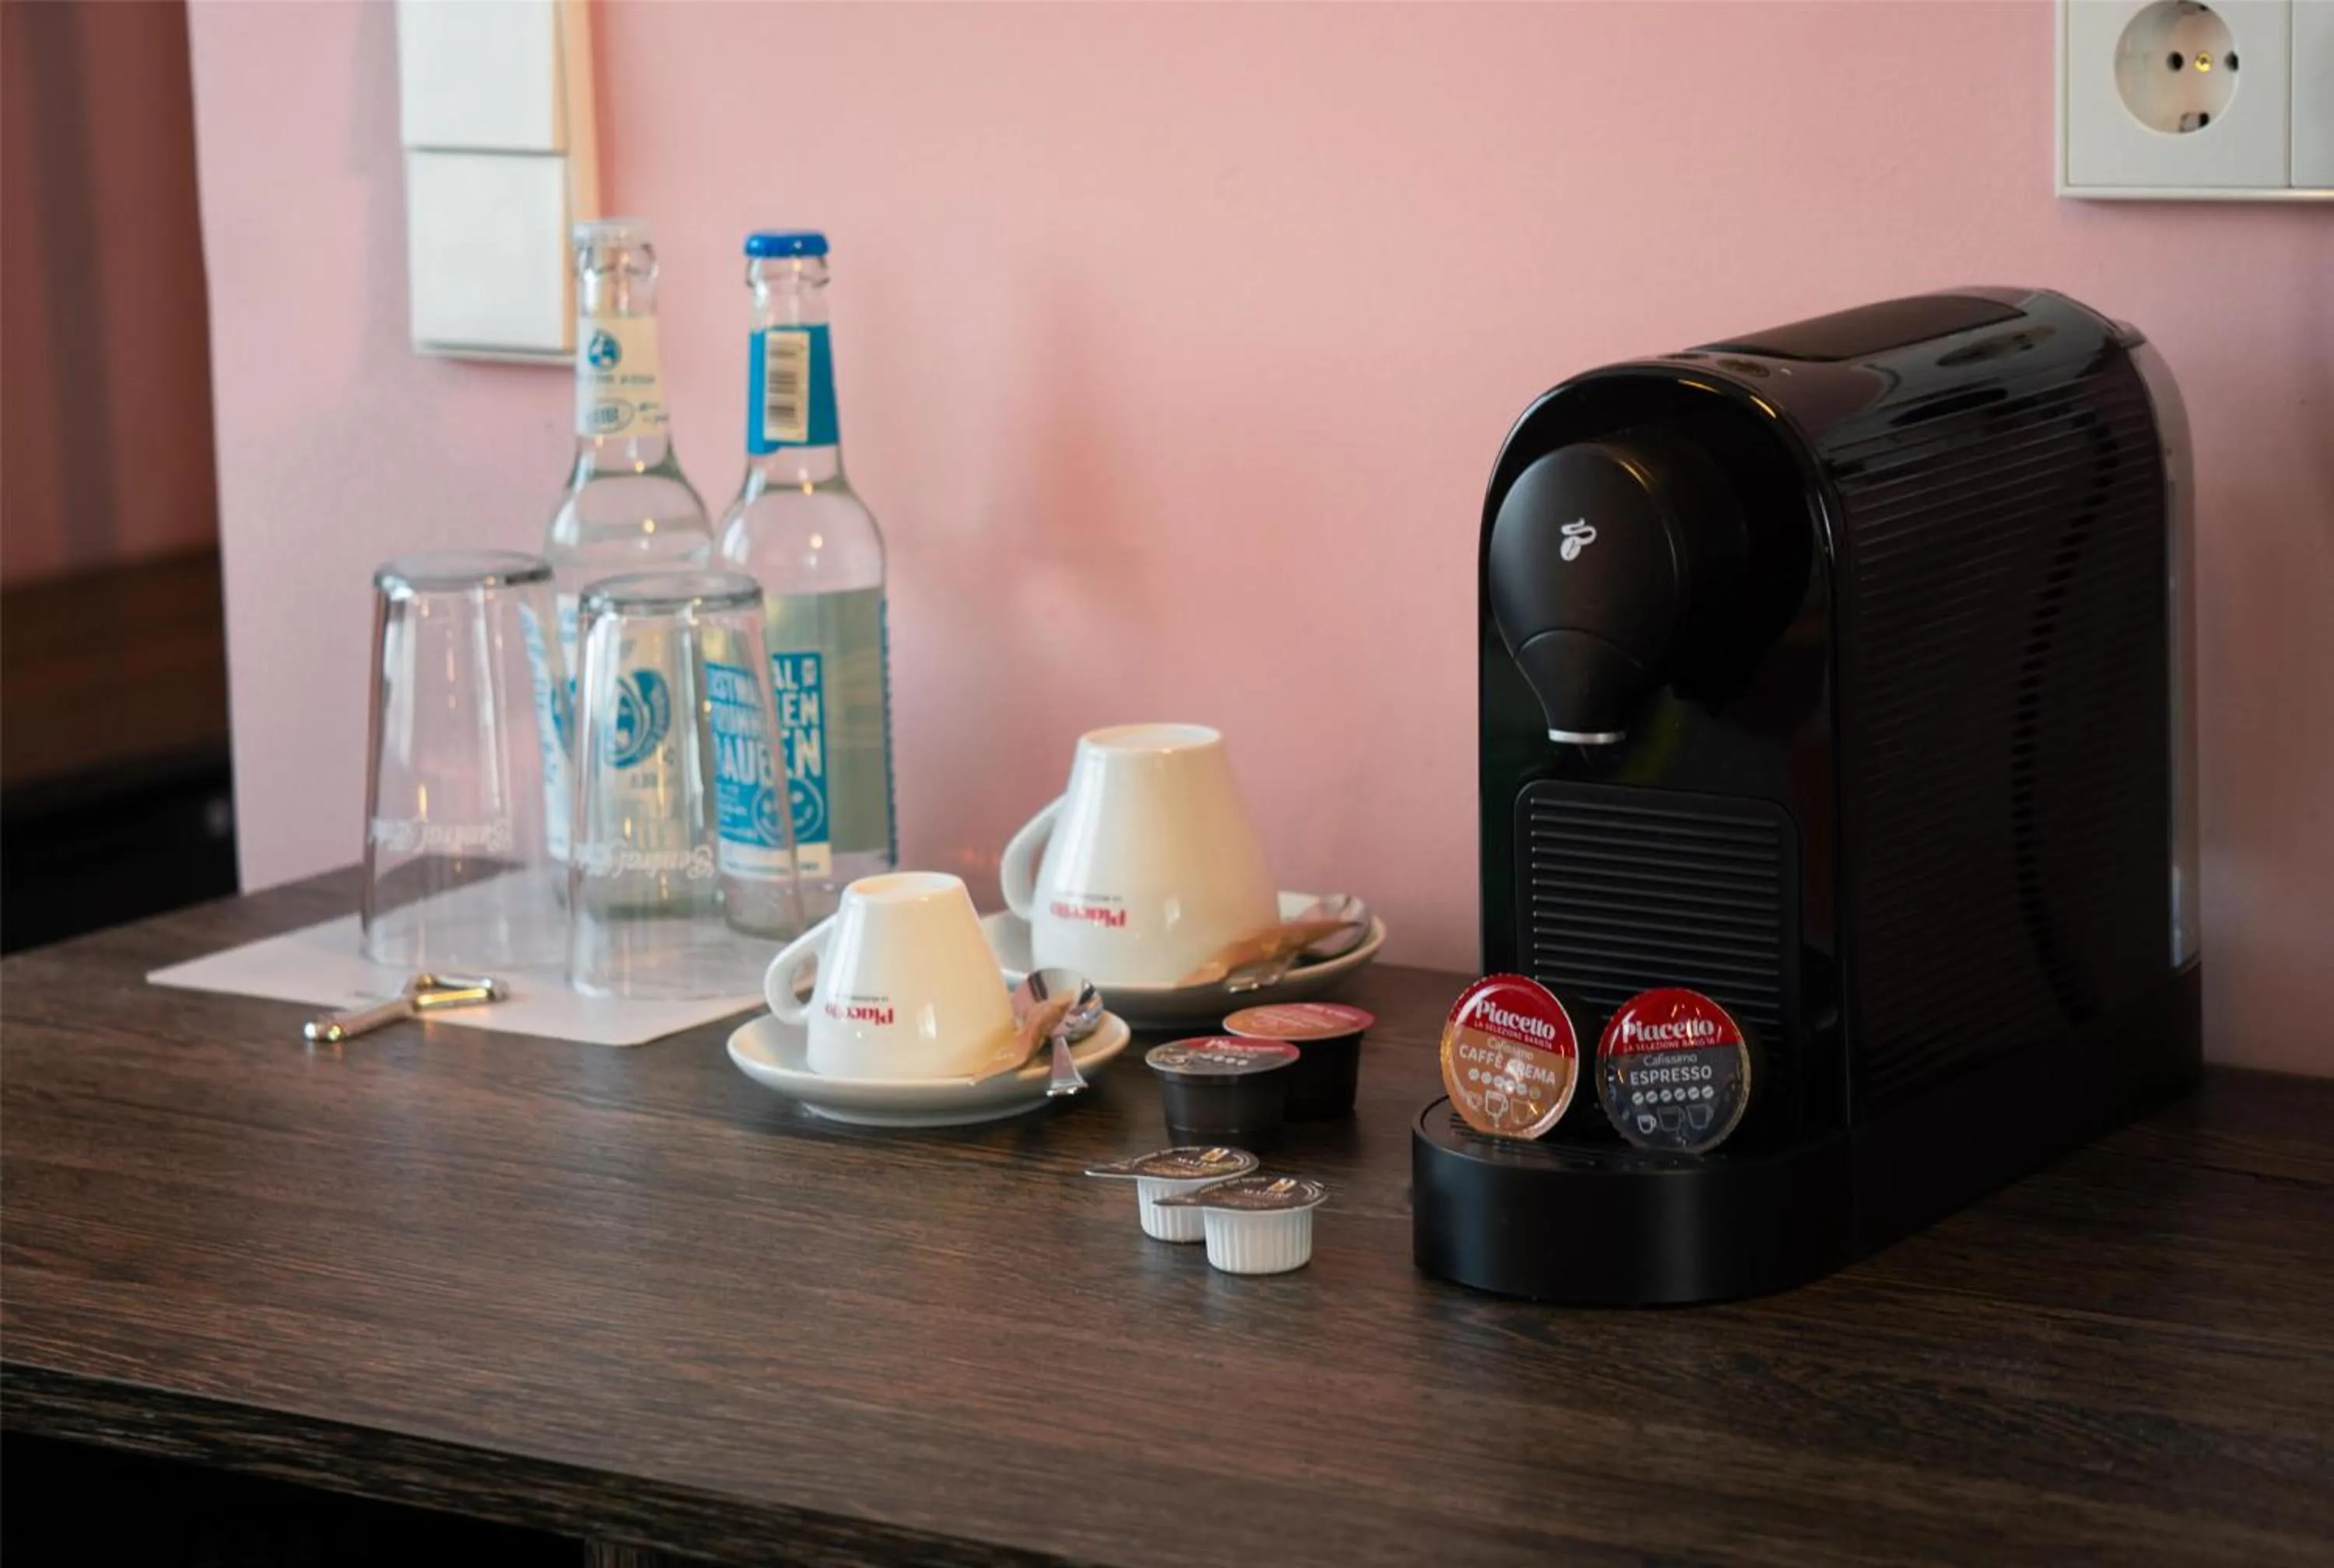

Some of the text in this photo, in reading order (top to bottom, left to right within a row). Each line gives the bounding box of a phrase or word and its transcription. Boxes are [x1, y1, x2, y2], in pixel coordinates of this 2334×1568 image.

[1475, 997, 1555, 1040] Piacetto
[1485, 1022, 1522, 1040] SELEZIONE
[1622, 1017, 1714, 1044] Piacetto
[1635, 1040, 1679, 1051] SELEZIONE
[1460, 1045, 1503, 1069] CAFFÈ
[1630, 1065, 1712, 1086] ESPRESSO
